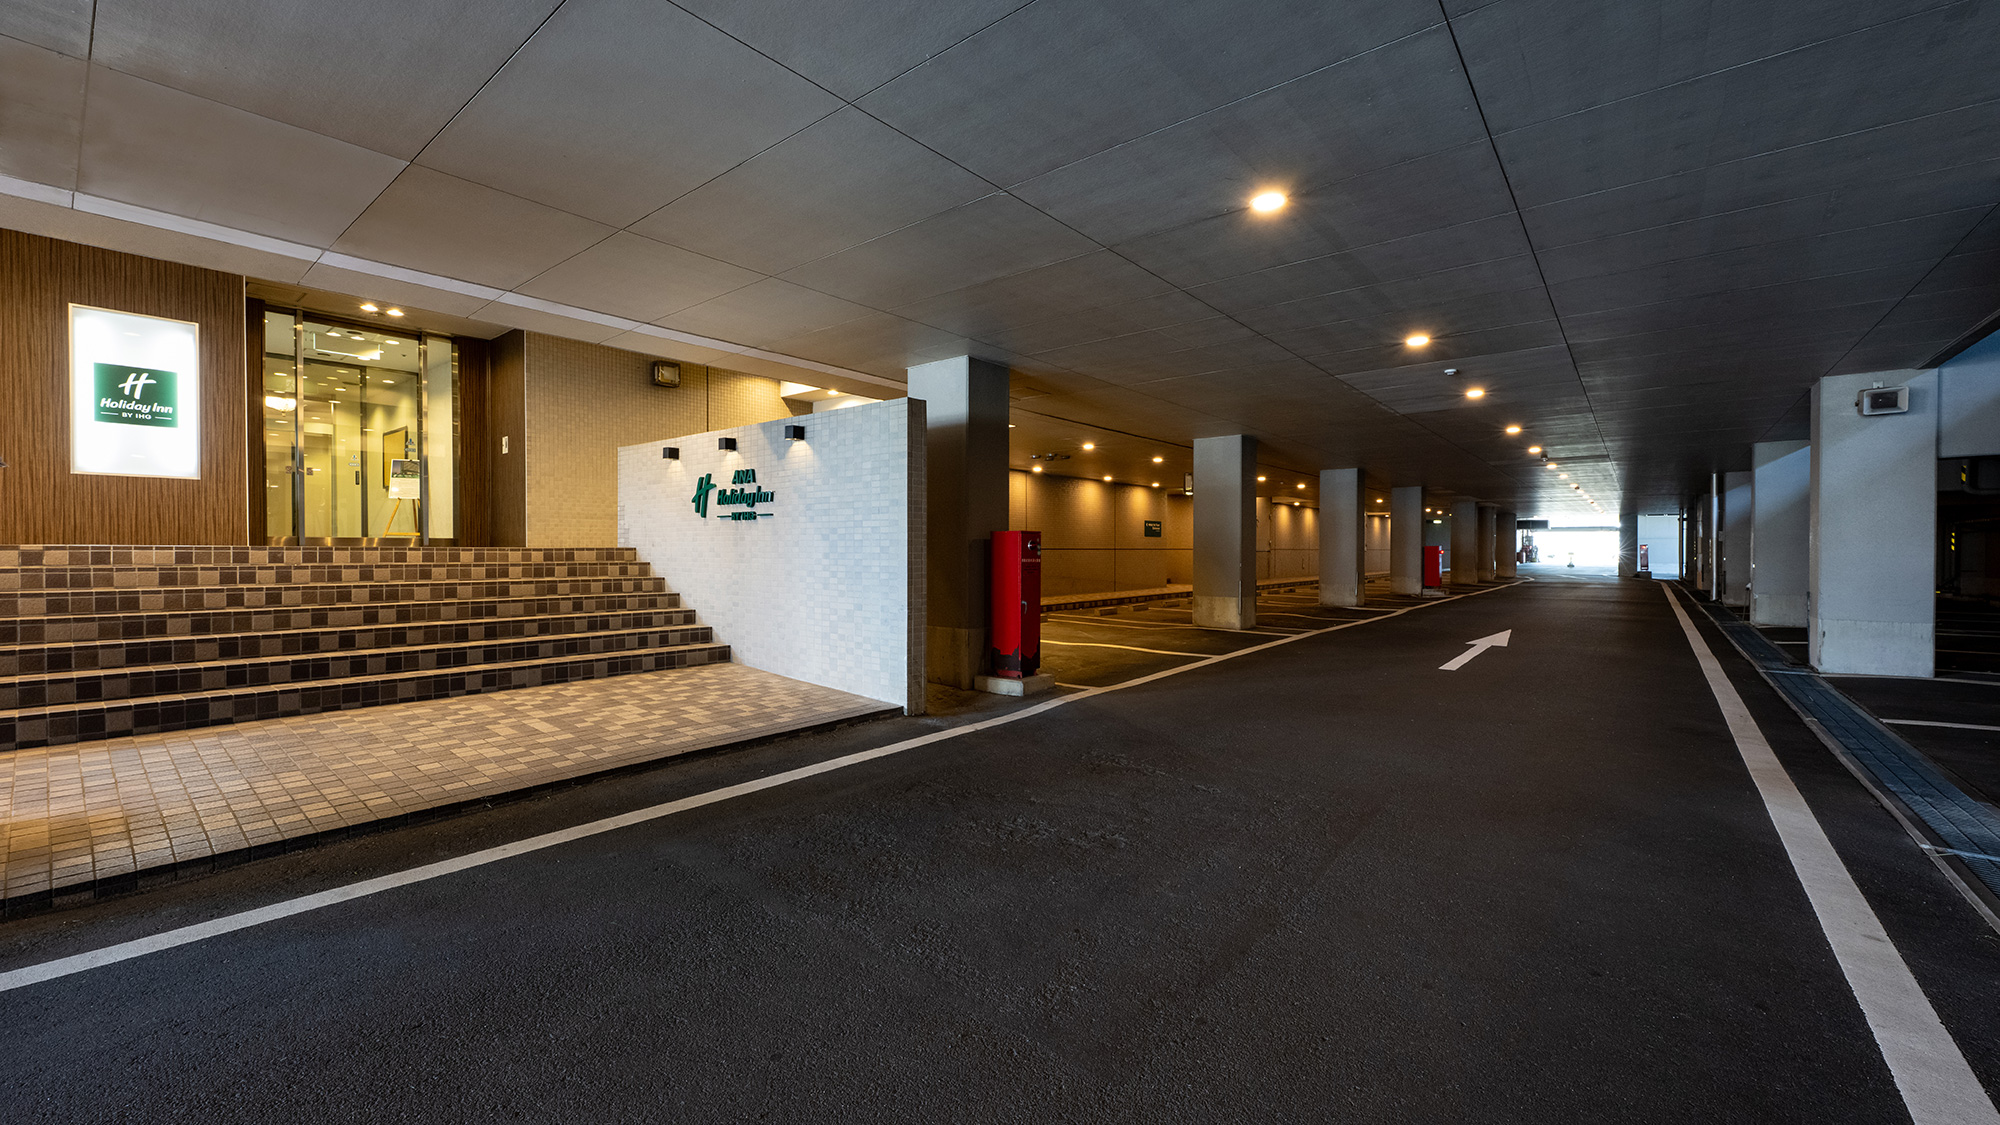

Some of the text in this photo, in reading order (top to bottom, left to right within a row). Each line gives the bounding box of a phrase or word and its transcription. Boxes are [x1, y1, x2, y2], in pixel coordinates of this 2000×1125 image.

[100, 397, 173, 414] Holiday Inn
[731, 469, 756, 485] ANA
[716, 485, 774, 508] Holiday Inn
[742, 511, 757, 520] IHG
